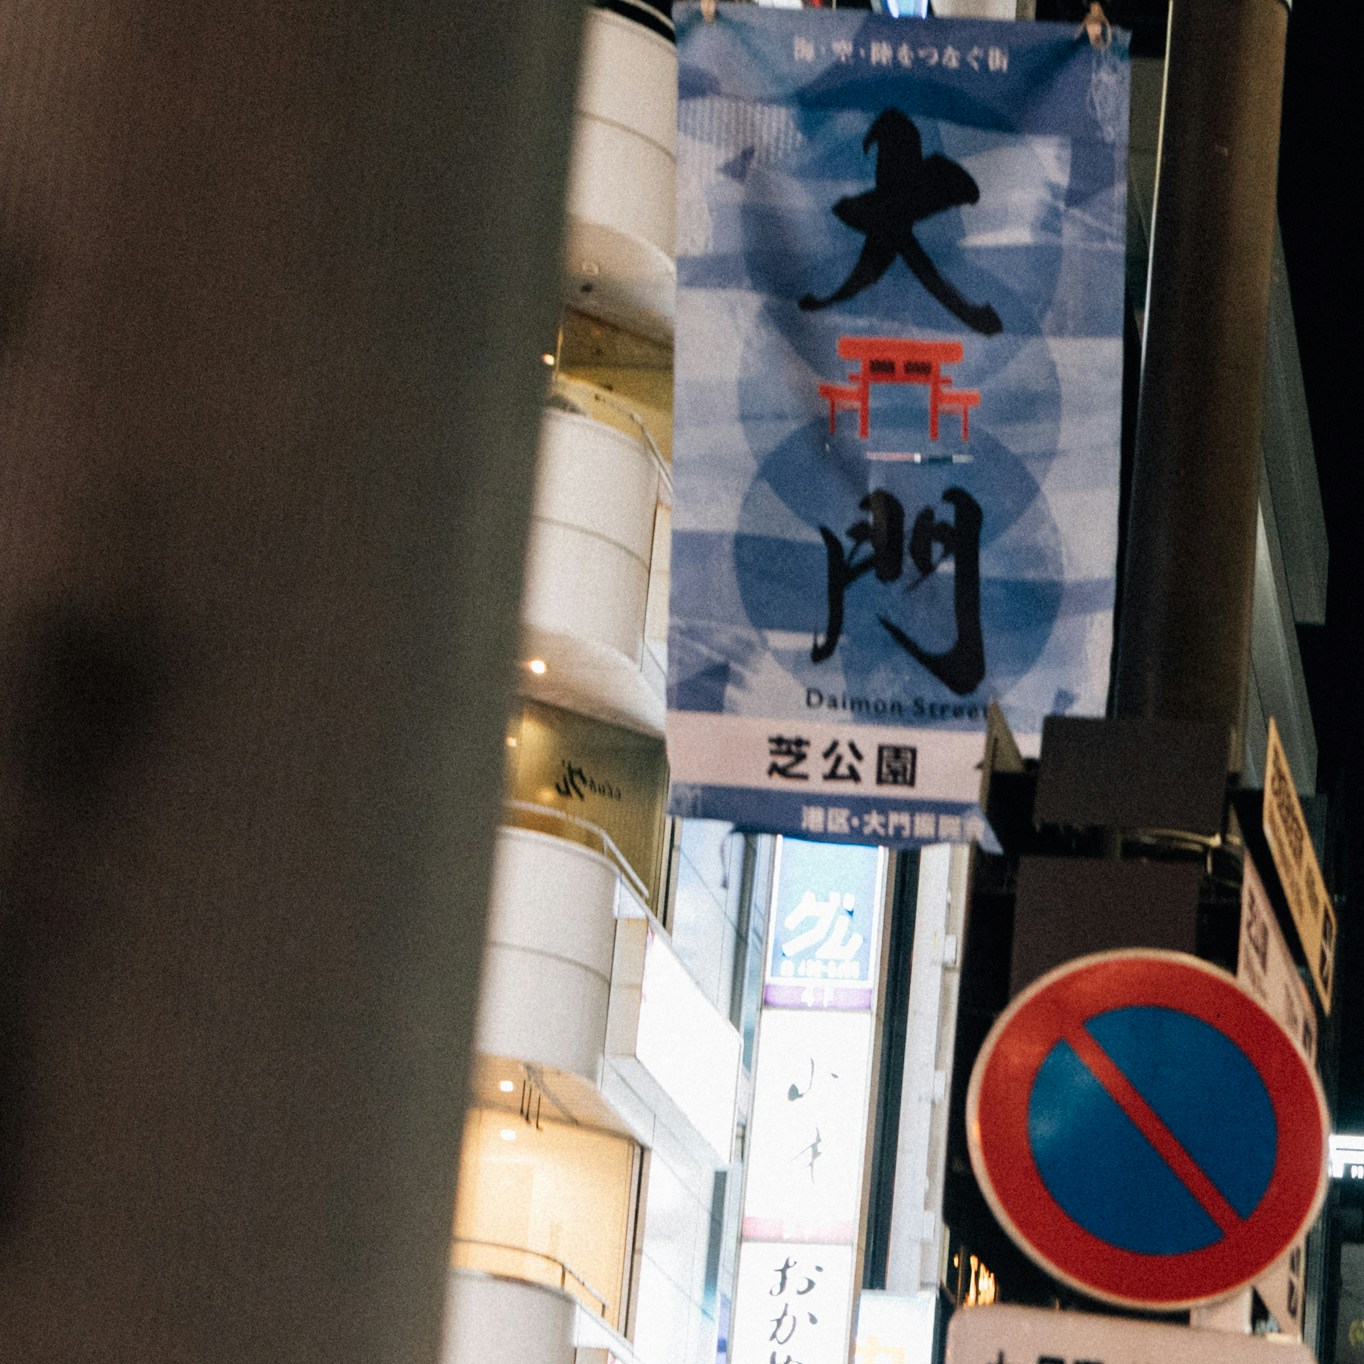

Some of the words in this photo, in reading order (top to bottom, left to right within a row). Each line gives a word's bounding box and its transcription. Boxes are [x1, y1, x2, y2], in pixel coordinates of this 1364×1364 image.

[805, 687, 903, 717] Daimon
[767, 735, 918, 788] 芝公園
